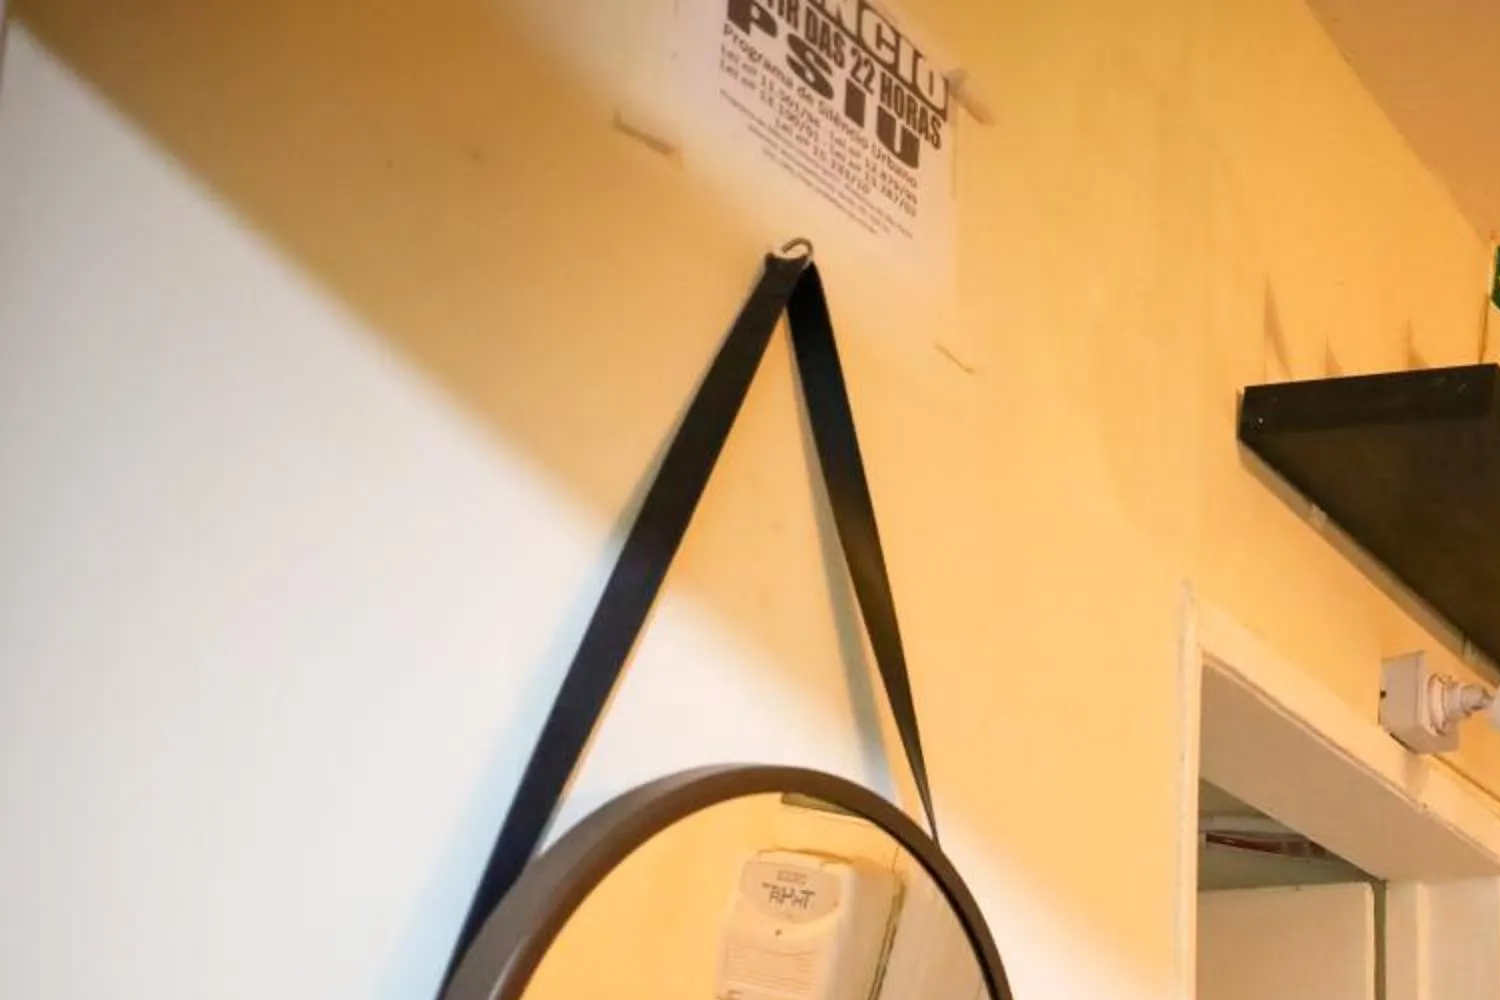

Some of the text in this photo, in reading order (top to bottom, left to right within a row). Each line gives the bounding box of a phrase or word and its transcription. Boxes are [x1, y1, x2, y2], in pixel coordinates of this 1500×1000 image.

[727, 0, 920, 169] PSIU
[805, 5, 845, 68] DAS
[851, 45, 875, 95] 22
[880, 71, 942, 150] HORAS
